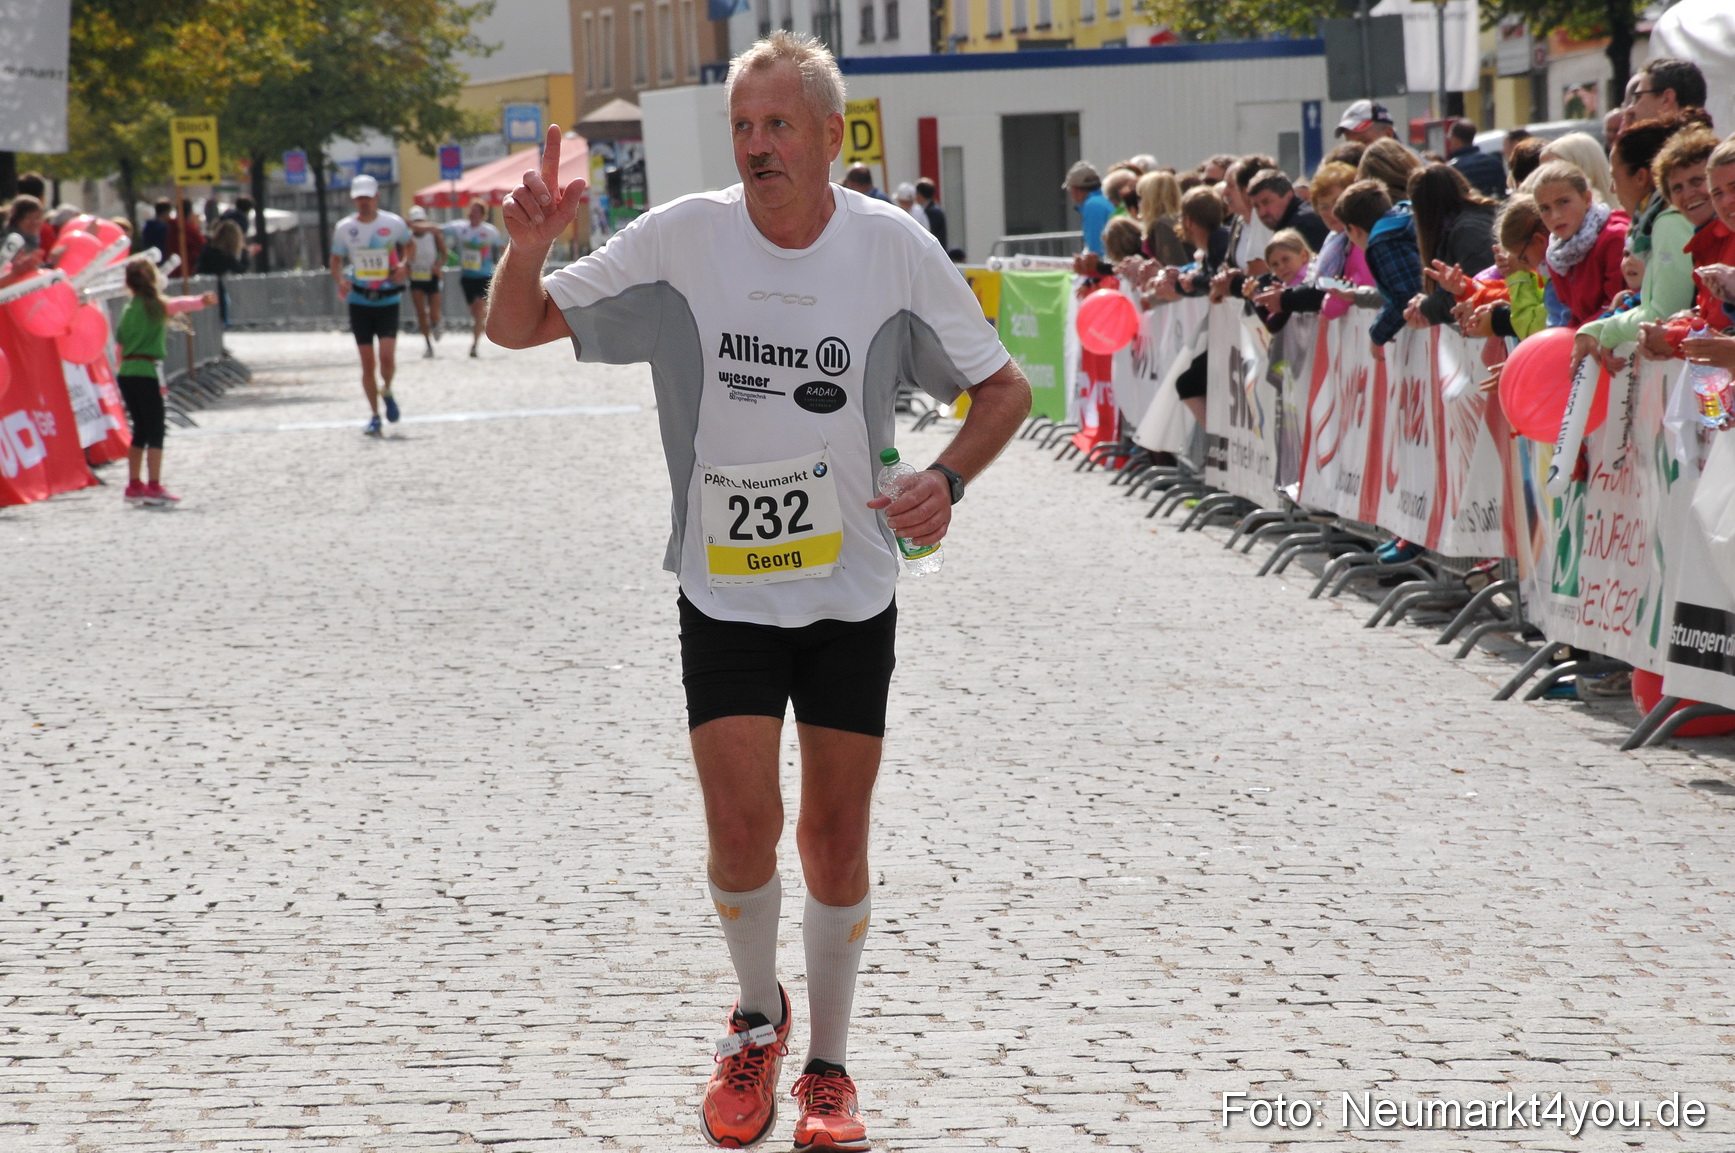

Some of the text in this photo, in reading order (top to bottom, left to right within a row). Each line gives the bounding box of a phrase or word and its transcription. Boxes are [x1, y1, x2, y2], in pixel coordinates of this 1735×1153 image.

[851, 120, 873, 152] D
[184, 138, 207, 169] D
[718, 332, 809, 369] Allianz
[805, 386, 839, 397] RADAU
[741, 470, 809, 490] Neumarkt
[728, 489, 814, 541] 232
[746, 550, 803, 570] Georg
[1670, 622, 1727, 654] stungen
